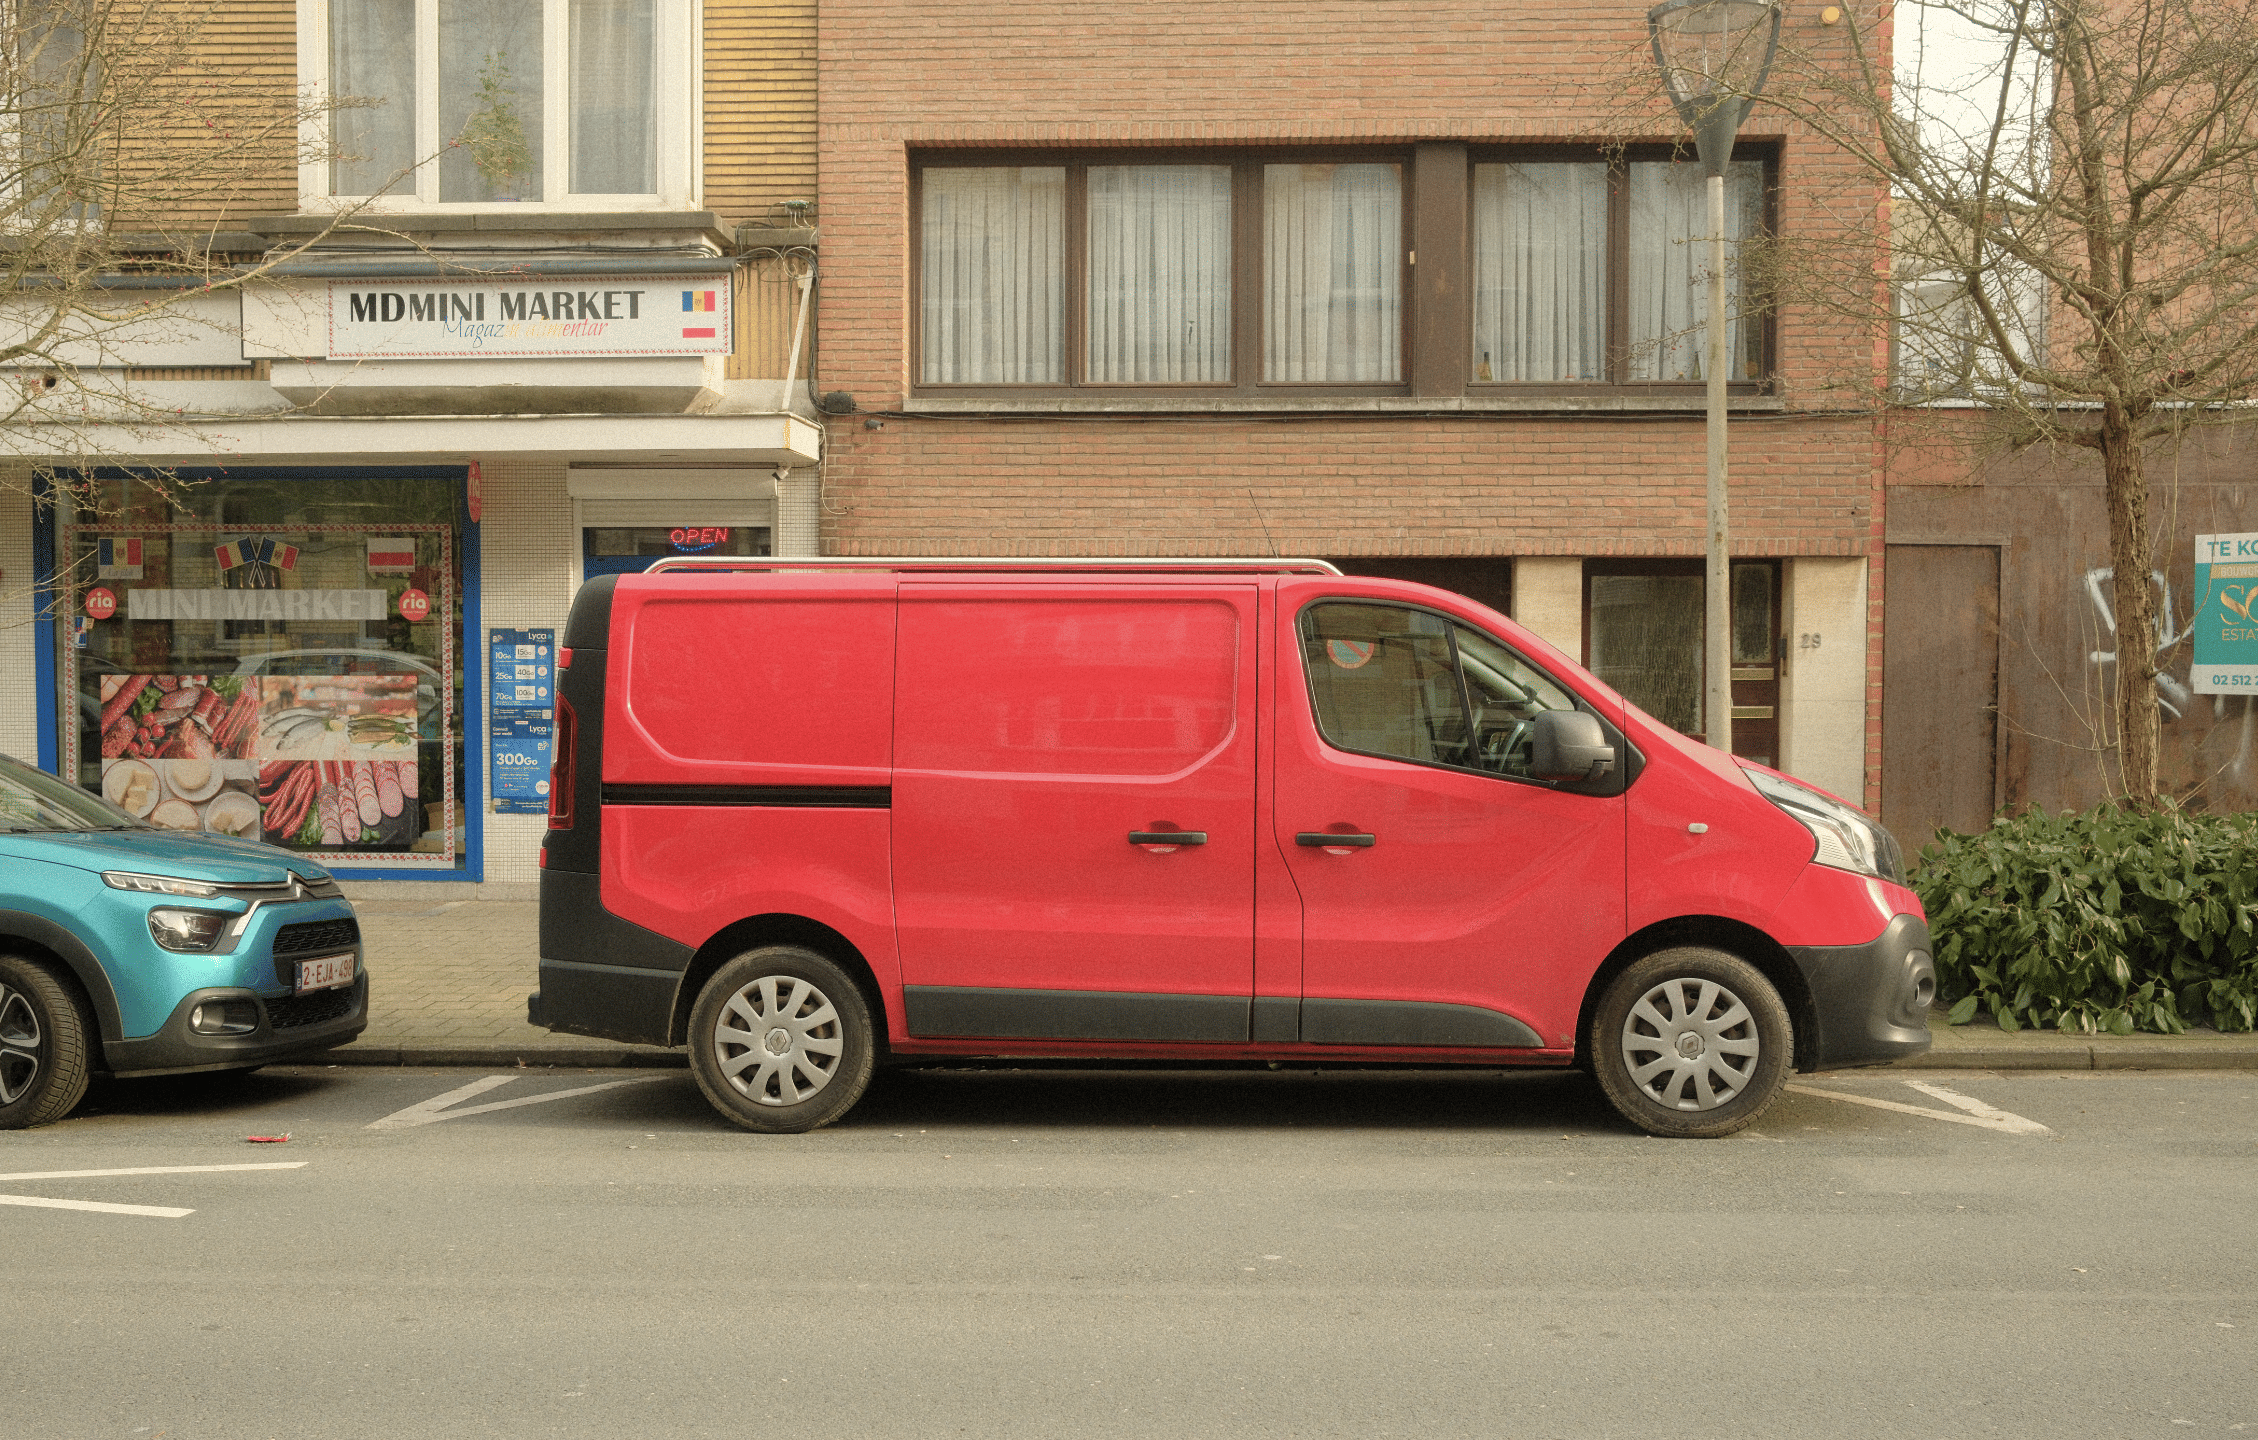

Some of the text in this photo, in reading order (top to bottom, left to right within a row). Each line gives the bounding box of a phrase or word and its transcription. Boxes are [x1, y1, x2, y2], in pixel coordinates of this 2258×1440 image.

[500, 290, 645, 320] MARKET
[442, 315, 608, 348] Magazin alimentar
[670, 528, 728, 543] OPEN
[2207, 541, 2231, 557] TE
[89, 591, 113, 607] ria
[128, 589, 387, 620] MINI MARKET
[402, 593, 427, 609] ria
[528, 632, 547, 641] Lyca
[1801, 632, 1821, 648] 29
[2212, 675, 2228, 685] 02
[2231, 675, 2251, 685] 512
[529, 725, 547, 734] Lyca
[496, 753, 538, 766] 300Go
